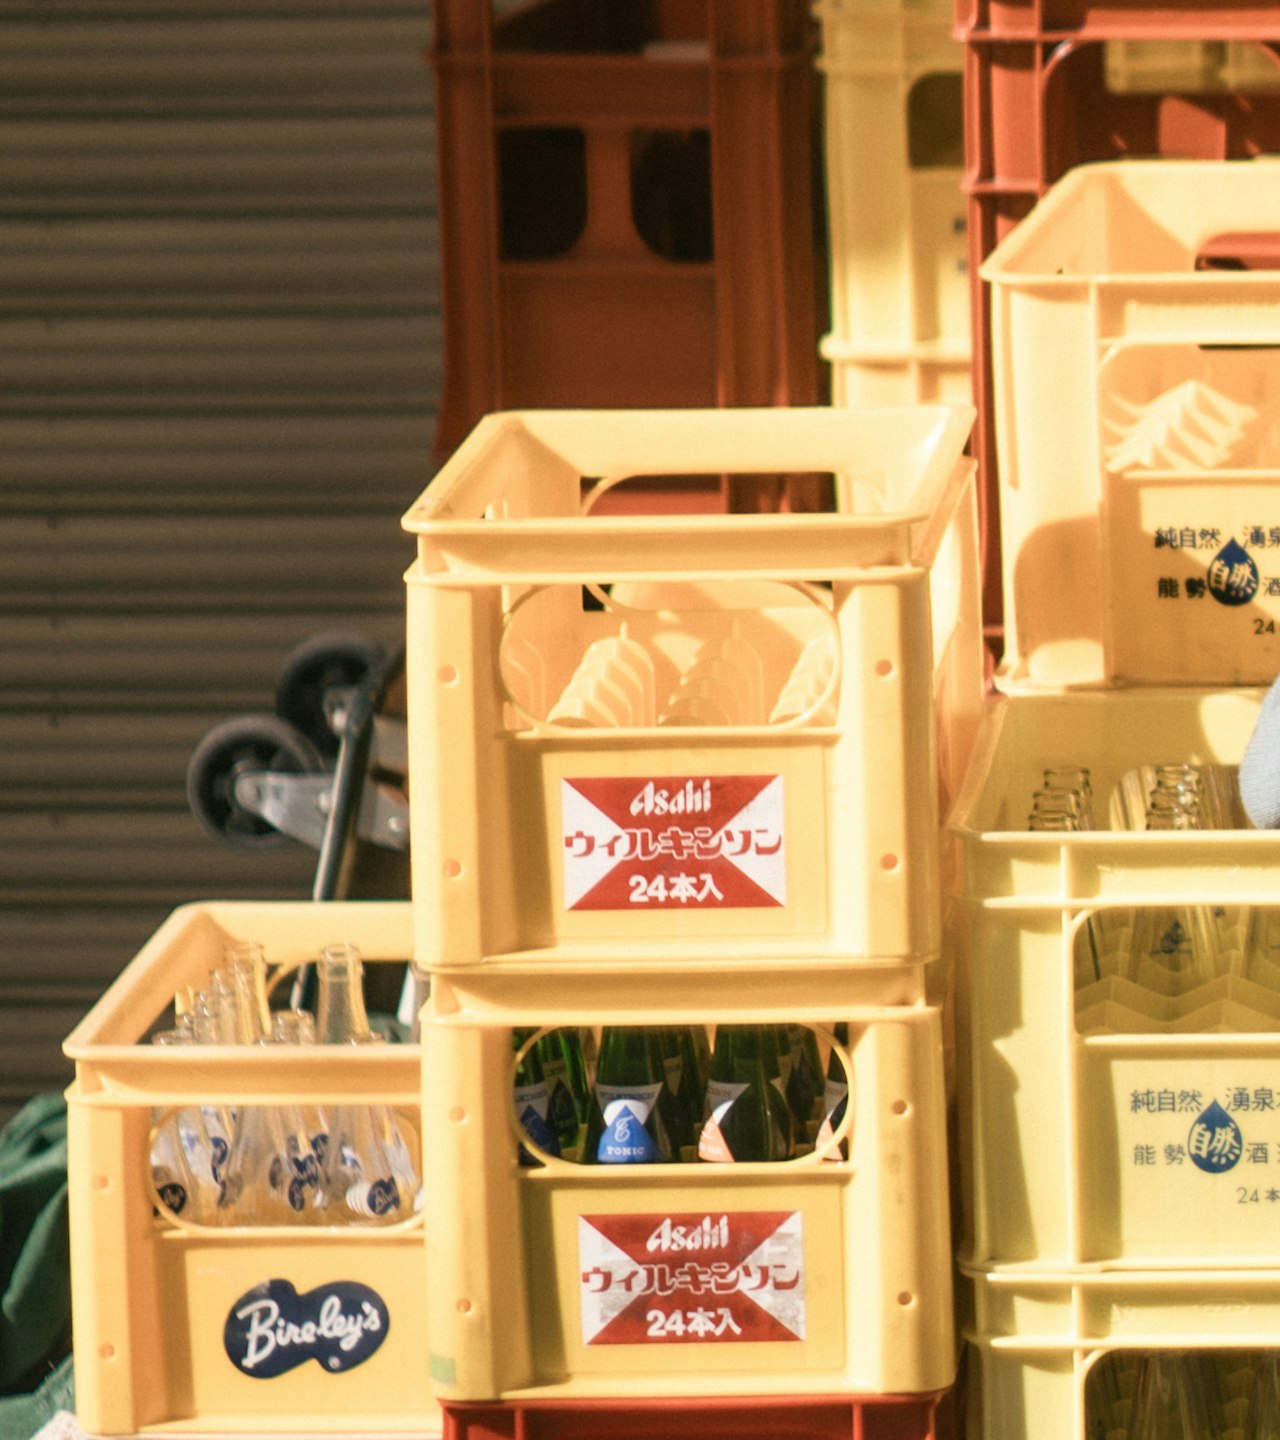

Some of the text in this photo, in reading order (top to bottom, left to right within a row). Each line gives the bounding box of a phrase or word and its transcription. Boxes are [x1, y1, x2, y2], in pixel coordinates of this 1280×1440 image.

[1155, 527, 1221, 549] 純自然
[629, 778, 712, 816] Asahi
[564, 826, 782, 861] ウィルキンソン
[628, 872, 724, 903] 24本入
[1130, 1088, 1203, 1113] 純自然
[606, 1146, 645, 1156] TONIC
[646, 1215, 729, 1252] Asahi
[582, 1262, 800, 1296] ウィルキンソン
[236, 1294, 381, 1368] Bireley's
[646, 1308, 742, 1338] 24本入
